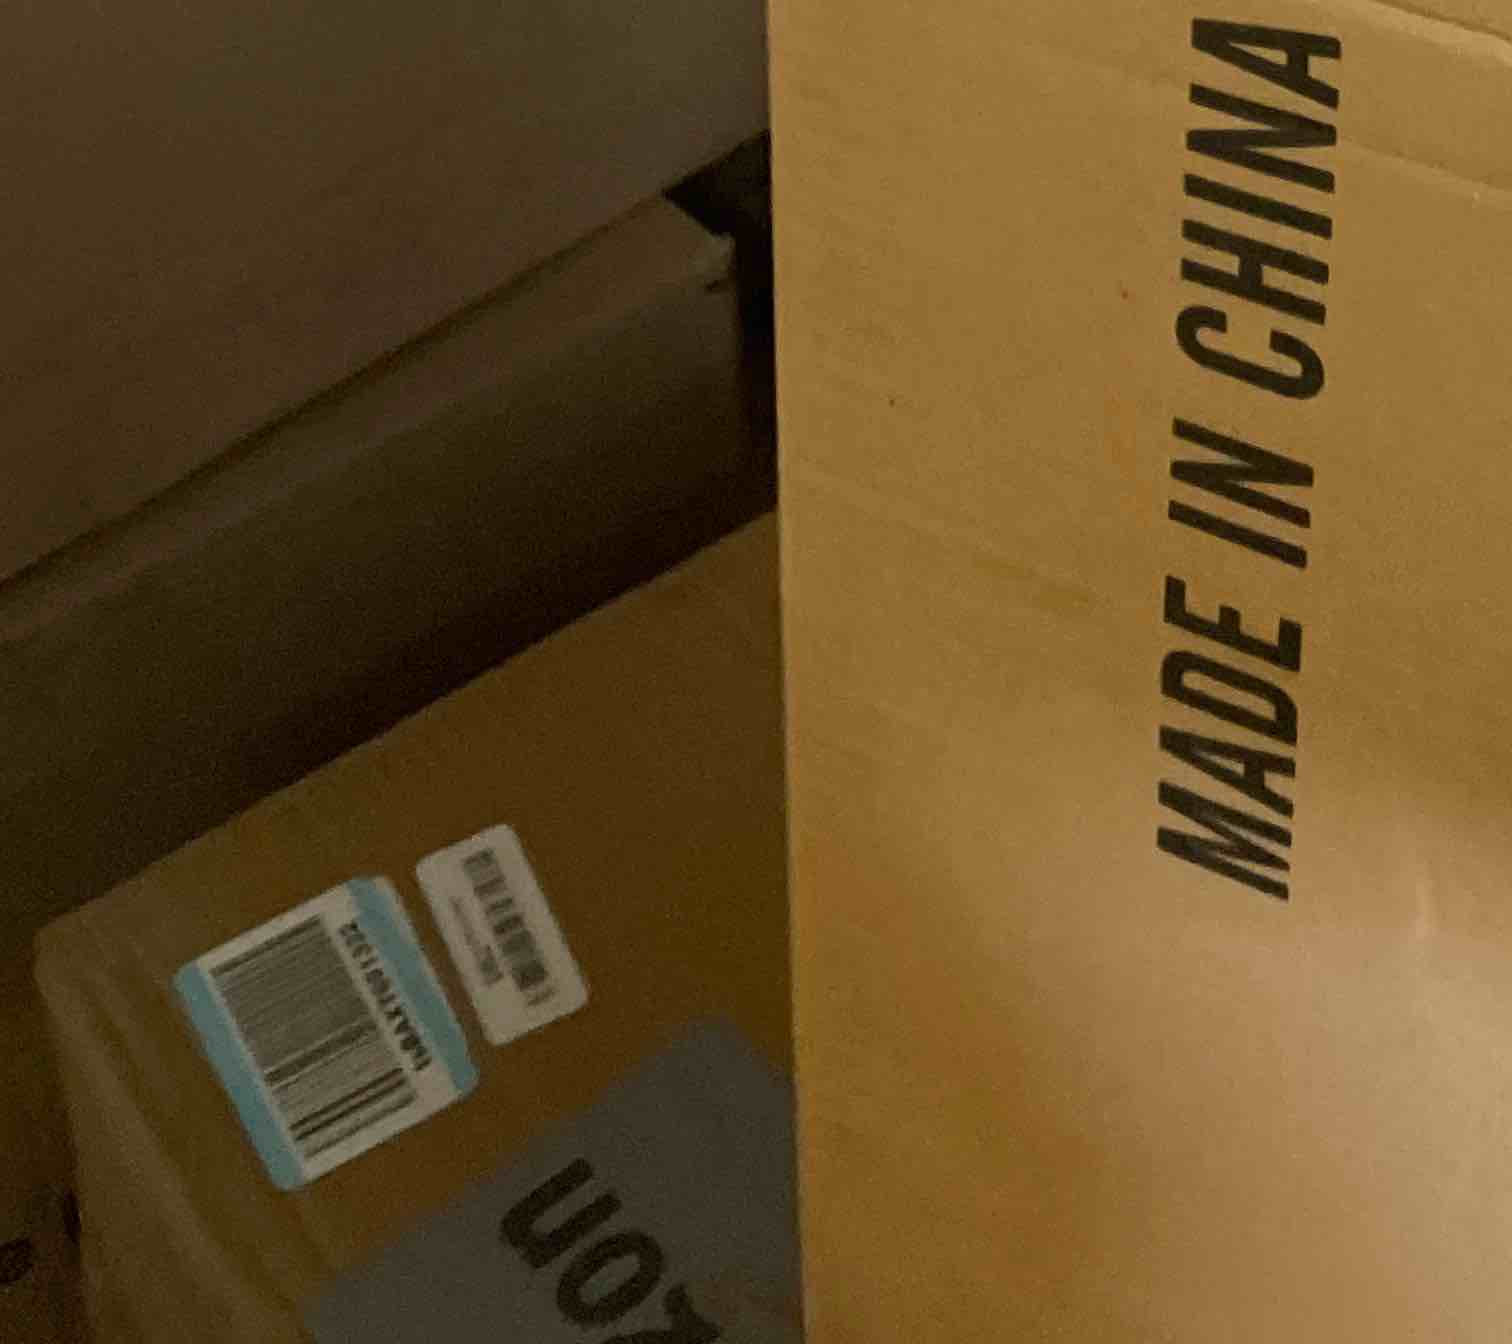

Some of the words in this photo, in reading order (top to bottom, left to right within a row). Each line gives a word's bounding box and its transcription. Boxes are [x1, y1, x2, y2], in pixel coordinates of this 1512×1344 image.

[1175, 17, 1343, 401] CHINA
[1167, 417, 1315, 569] IN
[1156, 573, 1304, 902] MADE
